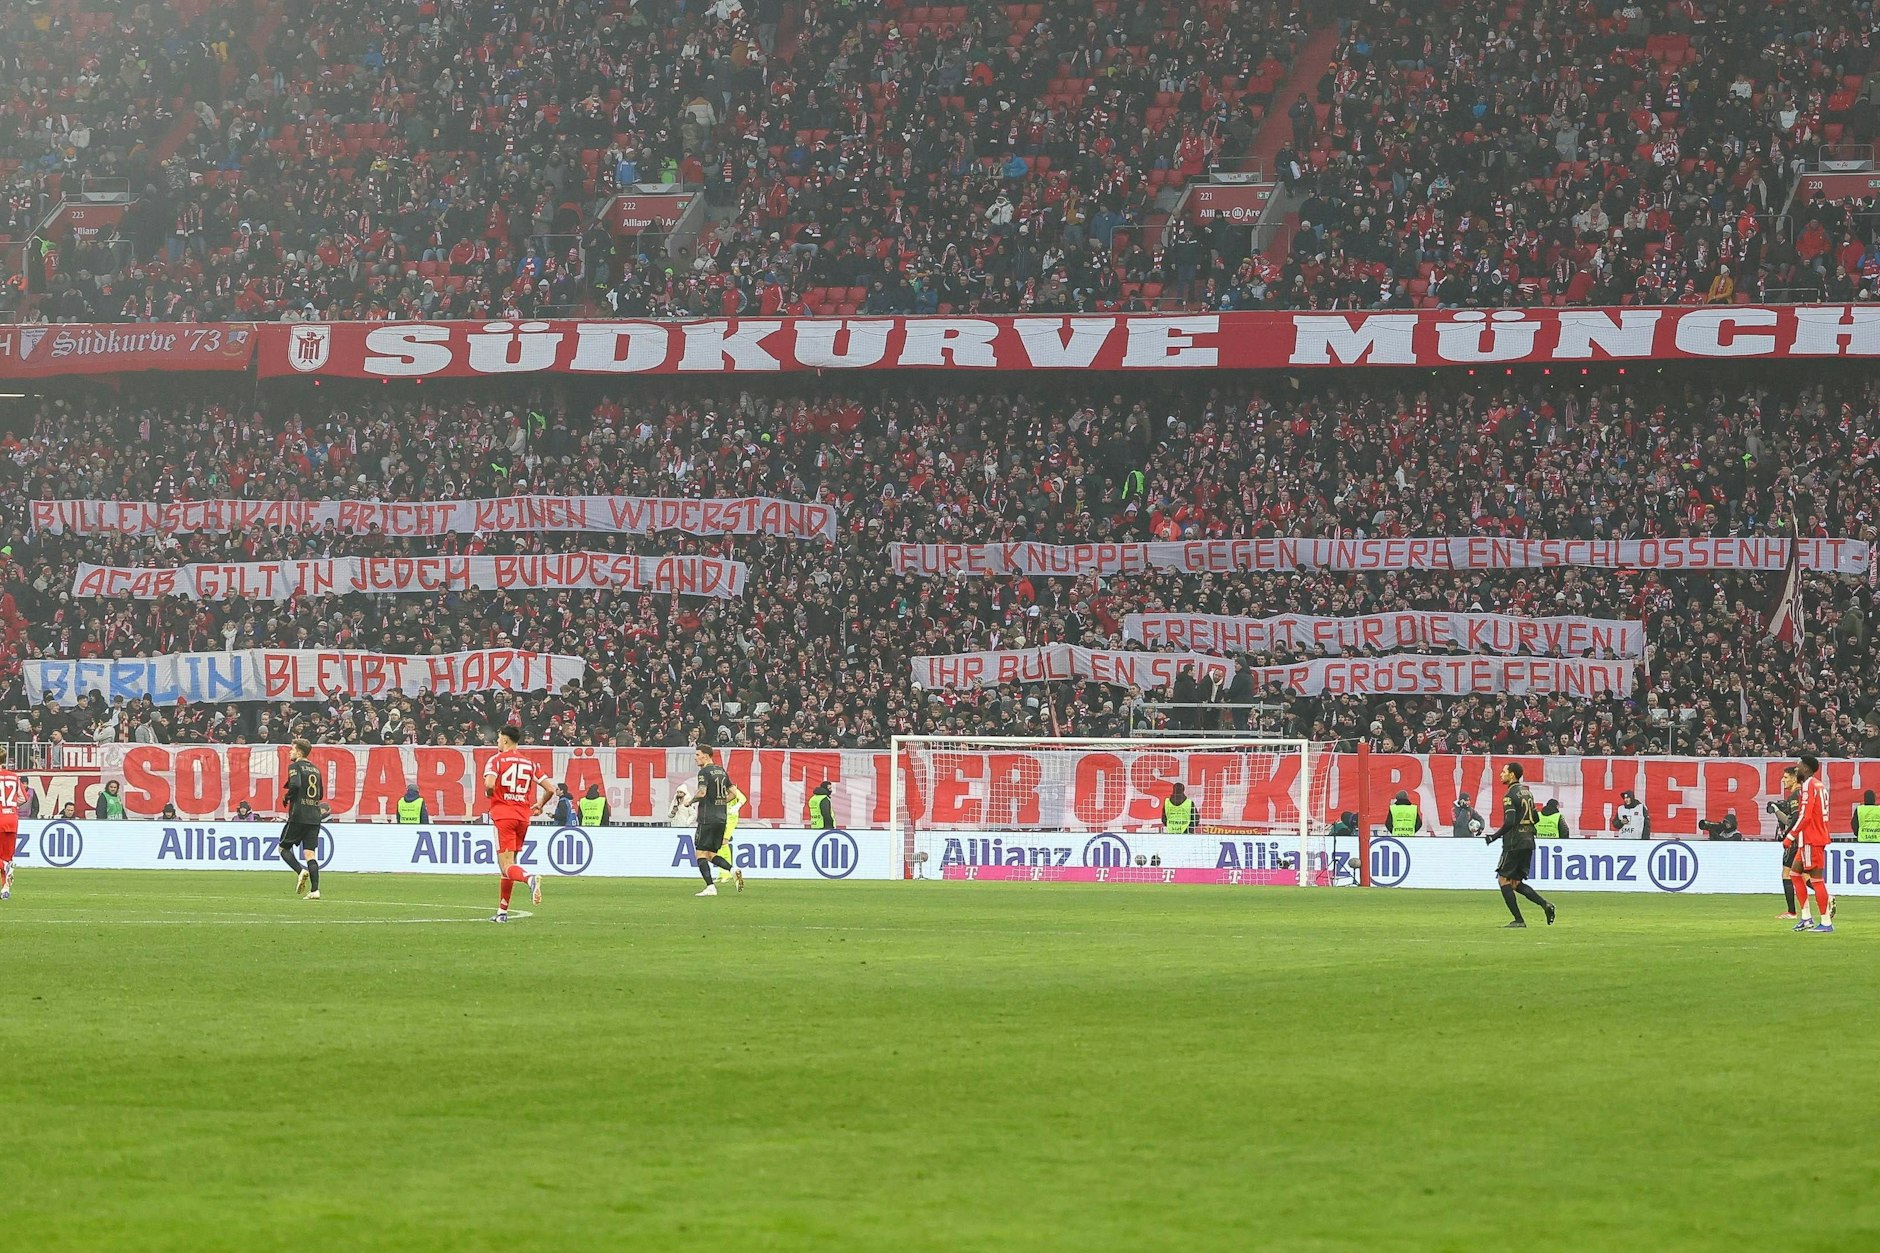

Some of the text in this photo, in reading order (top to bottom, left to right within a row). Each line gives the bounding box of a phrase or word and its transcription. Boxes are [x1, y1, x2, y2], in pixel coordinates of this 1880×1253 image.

[1200, 192, 1213, 201] 221
[1808, 181, 1823, 190] 220
[623, 202, 636, 210] 222
[51, 328, 177, 358] Südkurve
[184, 327, 222, 352] '73
[363, 307, 1880, 376] SÜDKURVE MÜNCH
[33, 497, 828, 538] BULLENSCHIKANE BRICHT KEINEN WIDERSTAND
[900, 543, 986, 572] EURE
[1184, 539, 1298, 571] GEGEN
[1312, 539, 1451, 568] UNSERE
[78, 551, 737, 599] ACAB GILT IN JEDEM BUNDESLAND!
[1142, 615, 1628, 657] FREIHEIT FÜR DIE KURVEN!
[40, 650, 553, 704] BERLIN BLEIBT HART!
[929, 657, 984, 687] IHR
[998, 649, 1135, 685] BULLEN
[1325, 660, 1492, 693] GRÖSSTE
[1503, 661, 1623, 697] FEIND!
[307, 774, 317, 798] 8
[501, 763, 533, 794] 45
[714, 776, 727, 799] 16
[873, 753, 1042, 824] DER
[157, 827, 280, 861] Allianz
[411, 831, 538, 864] Alliaz
[671, 835, 802, 869] Aanz
[939, 838, 1073, 870] Allianz
[1216, 841, 1351, 876] Allianz
[1526, 845, 1637, 881] llianz
